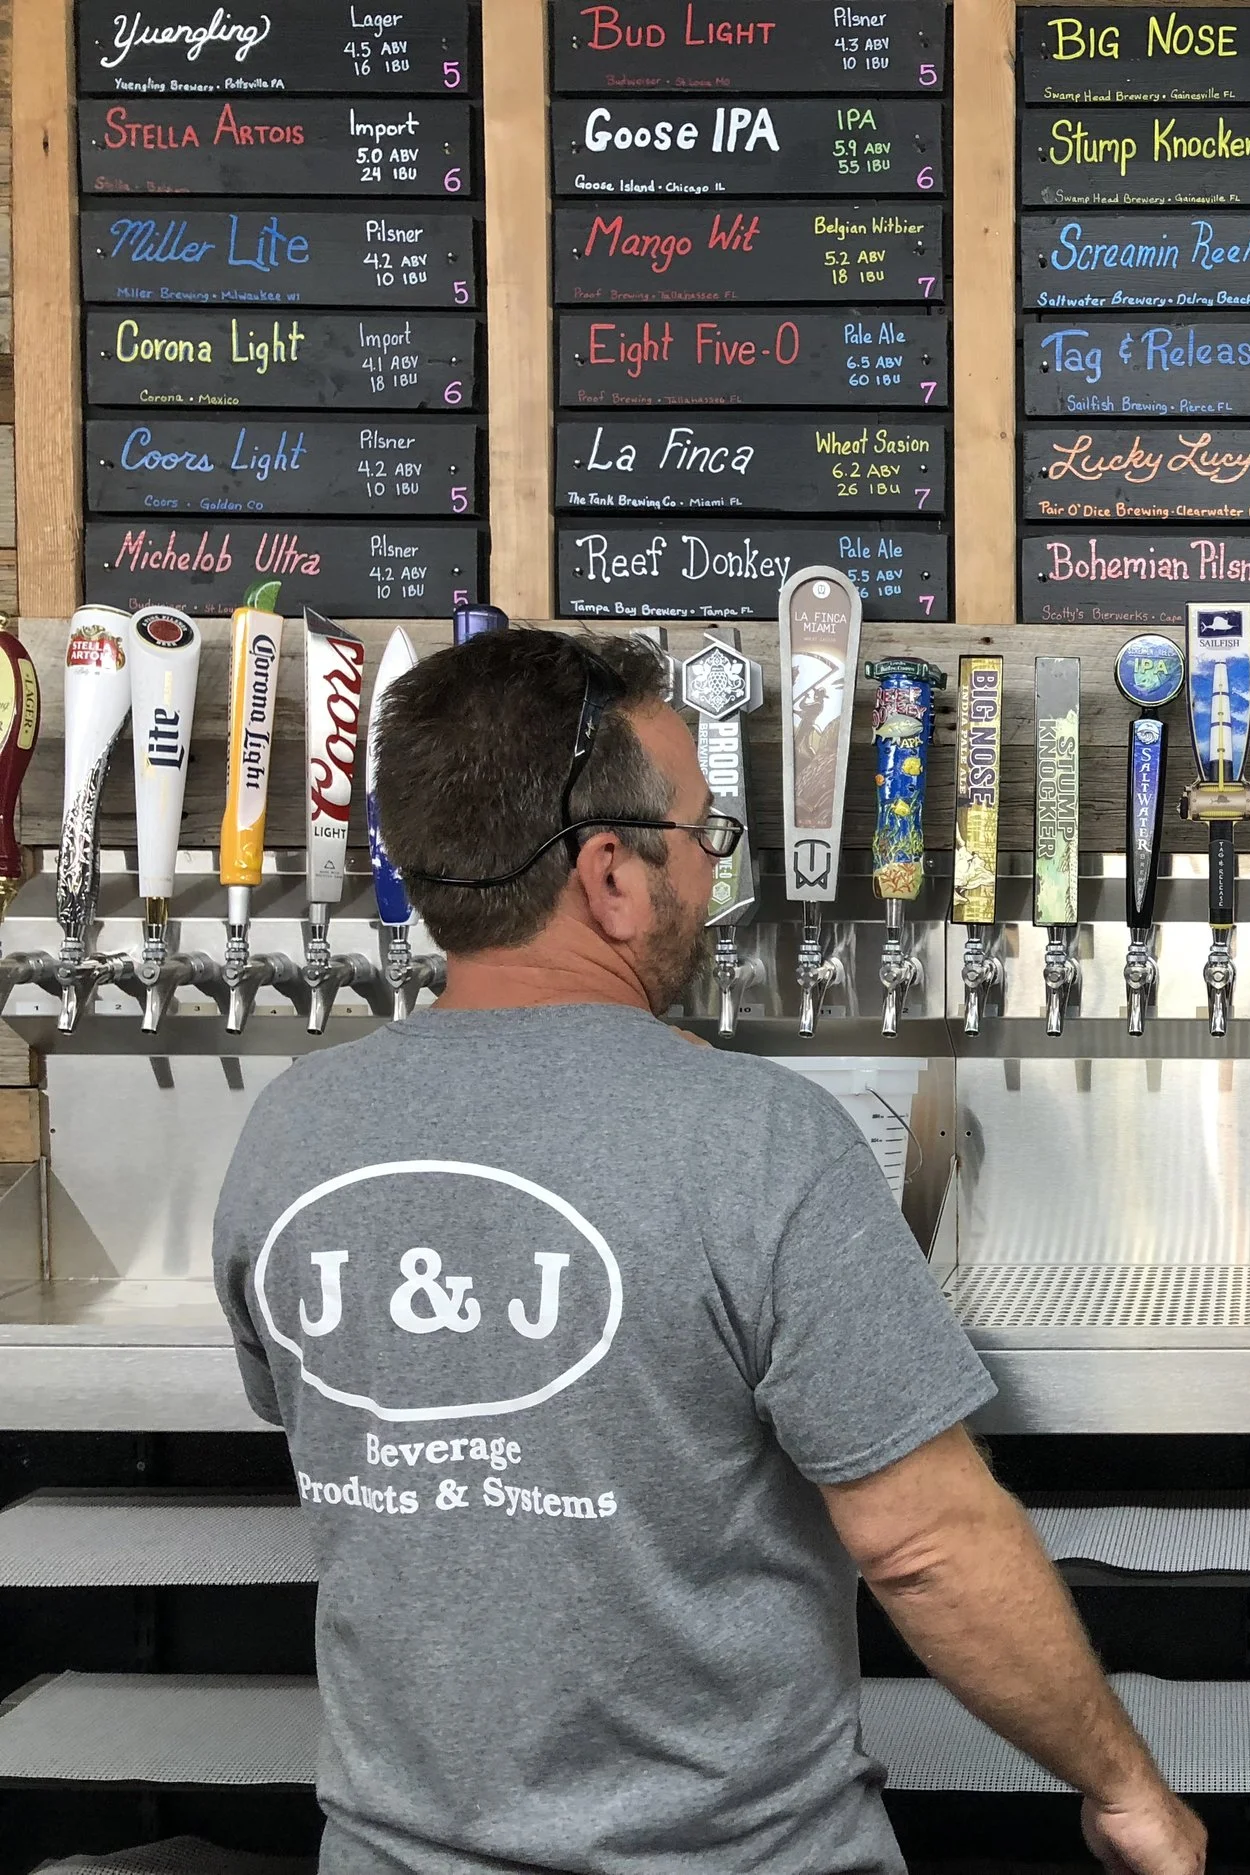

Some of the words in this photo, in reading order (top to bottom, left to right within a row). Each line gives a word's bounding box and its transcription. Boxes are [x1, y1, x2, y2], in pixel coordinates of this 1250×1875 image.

[100, 7, 271, 69] Yuengling
[350, 5, 403, 38] Lager
[580, 5, 666, 50] BUD
[685, 3, 776, 46] LIGHT
[1047, 18, 1120, 60] BIG
[1147, 11, 1238, 57] NOSE
[343, 41, 371, 58] 4.5
[380, 40, 407, 56] ABV
[354, 59, 371, 76] 16
[385, 59, 410, 73] IBU
[443, 61, 461, 88] 5
[1043, 86, 1081, 103] Swamp
[1083, 89, 1111, 103] Head
[1115, 91, 1160, 102] Brewery
[1170, 87, 1221, 101] Gainesville
[1223, 90, 1236, 98] FL
[104, 106, 200, 150] STELLA
[213, 102, 305, 145] ARTOIS
[349, 108, 420, 144] Import
[711, 107, 780, 153] IPA
[837, 108, 877, 131] IPA
[1049, 119, 1137, 177] Stump
[574, 174, 615, 192] Goose
[620, 179, 656, 193] Island
[665, 181, 710, 195] Chicago
[715, 182, 726, 191] IL
[110, 218, 216, 263] Miller
[227, 214, 310, 273] Lite
[366, 219, 424, 243] Pilsner
[584, 215, 692, 274] Mango
[708, 213, 760, 252] Wit
[814, 215, 867, 241] Belgian
[872, 216, 925, 234] Witbier
[1050, 222, 1179, 271] Screamin
[1036, 291, 1106, 307] Saltwater
[1110, 290, 1167, 307] Brewery
[1176, 292, 1214, 307] Delray
[116, 319, 212, 363] Corona
[231, 318, 305, 375] Light
[589, 321, 674, 378] Eight
[1040, 329, 1102, 384] Tag
[1118, 332, 1134, 365] &
[120, 427, 215, 472] Coors
[230, 427, 307, 481] Light
[587, 426, 636, 472] La
[659, 427, 755, 475] Finca
[815, 427, 869, 456] Wheat
[873, 429, 930, 454] Sasion
[1048, 434, 1164, 484] Lucky
[114, 529, 232, 573] Michelob
[255, 532, 321, 576] Ultra
[575, 534, 668, 584] Reef
[681, 534, 791, 592] Donkey
[1046, 538, 1190, 581] Bohemian
[795, 611, 809, 623] LA
[814, 612, 847, 625] FINCA
[803, 622, 837, 634] MIAMI
[1199, 639, 1240, 648] SAILFISH
[23, 679, 33, 728] LAGER
[249, 633, 276, 726] Corona
[972, 669, 998, 723] BIG
[147, 707, 185, 772] Lite
[311, 637, 365, 822] Coors
[242, 728, 271, 790] Light
[708, 722, 739, 798] PROOF
[968, 726, 996, 807] NOSE
[1037, 719, 1057, 858] KNOCKER
[1057, 736, 1076, 840] STUMP
[1137, 748, 1152, 852] SALTWATER
[314, 826, 346, 839] LIGHT
[300, 1250, 349, 1337] J
[390, 1247, 481, 1334] &
[507, 1252, 570, 1339] J
[366, 1433, 522, 1470] Beverage
[298, 1471, 419, 1514] Products
[435, 1479, 469, 1511] &
[483, 1477, 618, 1519] Systems
